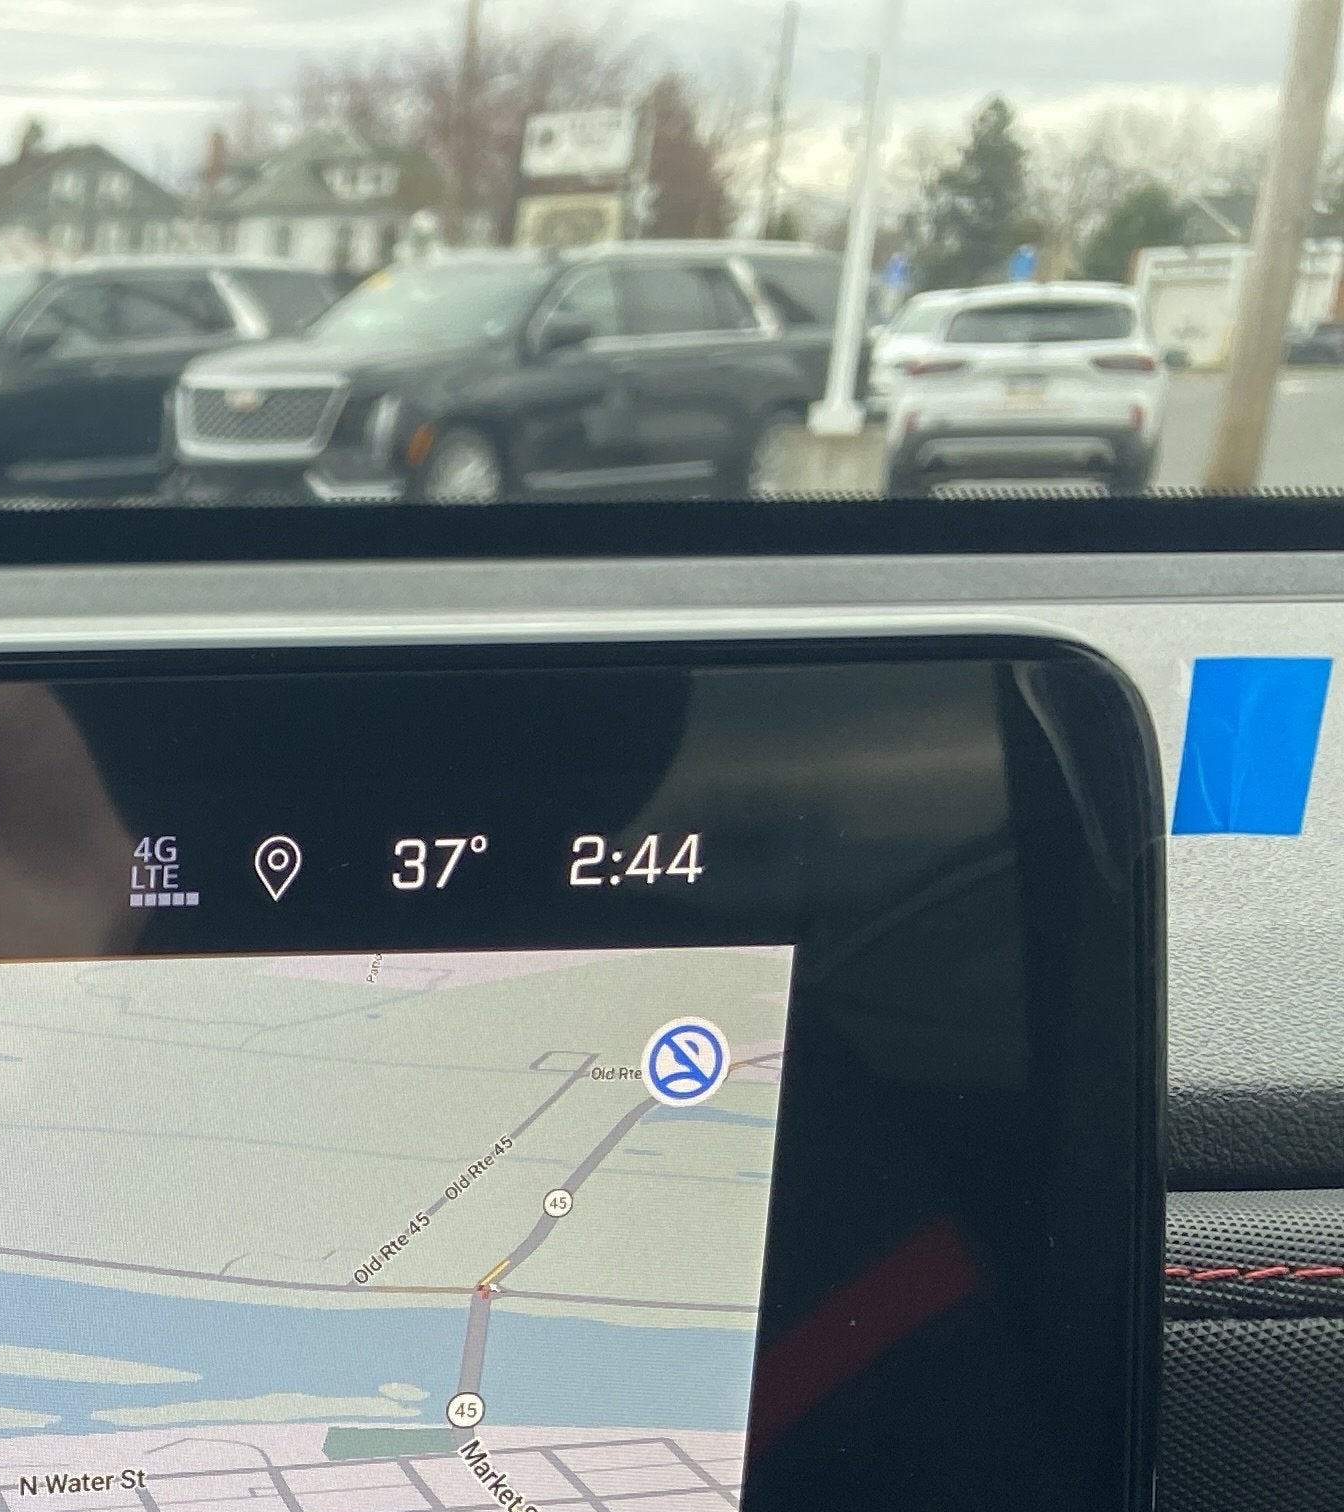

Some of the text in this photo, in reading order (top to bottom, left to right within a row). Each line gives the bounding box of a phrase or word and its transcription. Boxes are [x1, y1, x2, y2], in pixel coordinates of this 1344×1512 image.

[134, 836, 177, 862] 4G
[569, 833, 704, 886] 2:44
[131, 864, 179, 889] LTE
[592, 1067, 642, 1080] Old Rte
[445, 1135, 513, 1201] Old Rte 45
[550, 1196, 567, 1209] 45
[353, 1212, 430, 1284] Old Rte 45
[455, 1402, 477, 1418] 45
[20, 1470, 147, 1495] N Water St
[461, 1439, 523, 1512] Market
